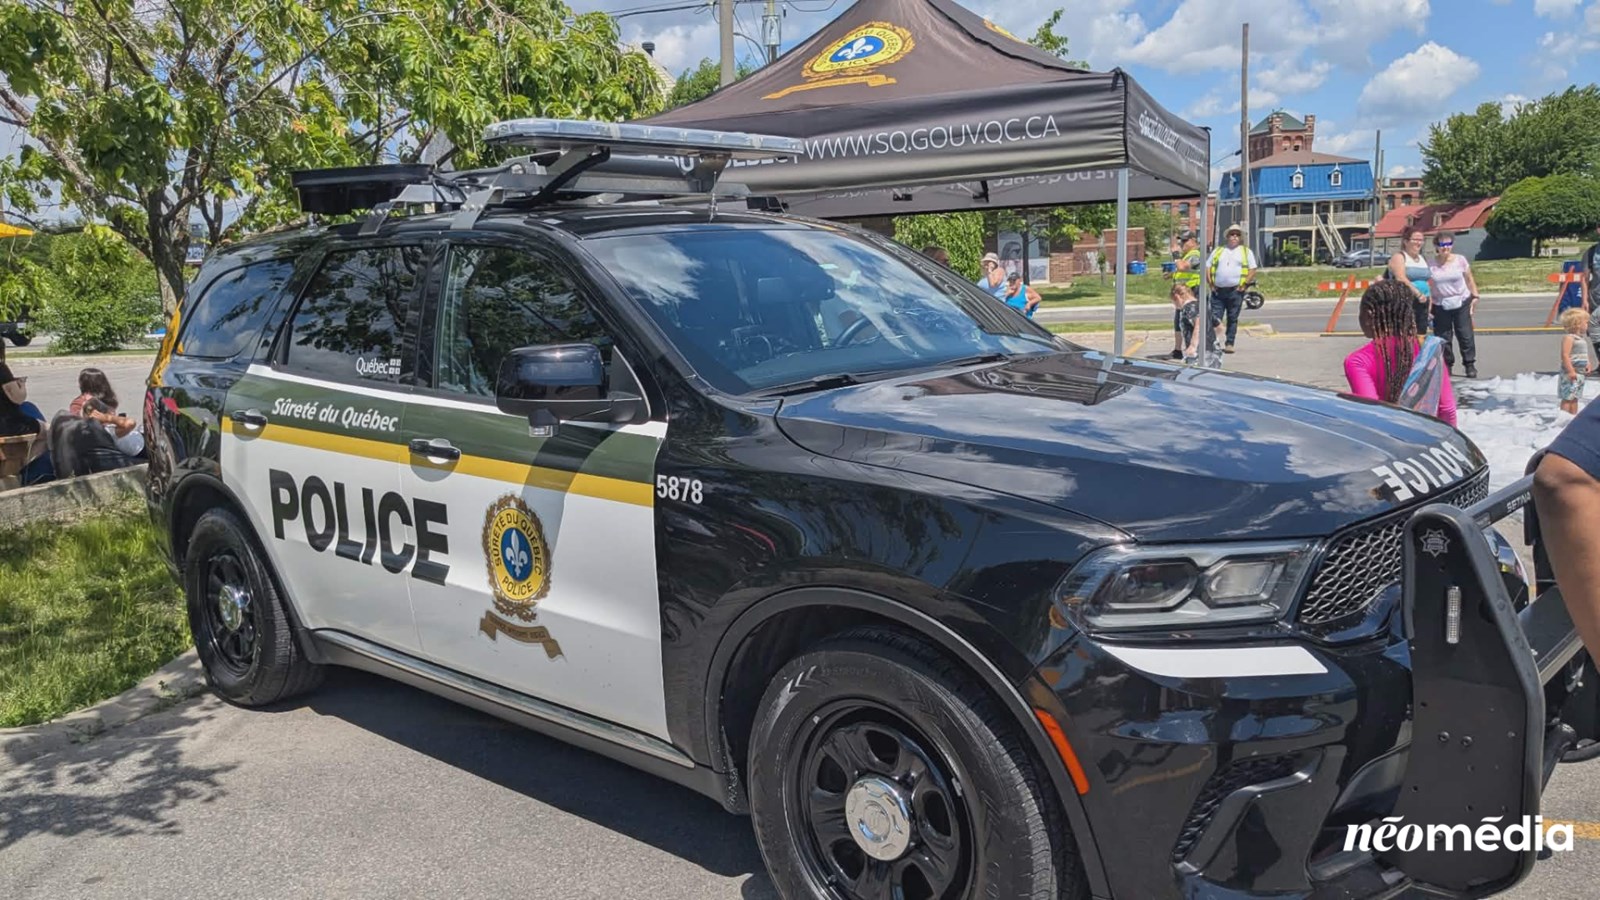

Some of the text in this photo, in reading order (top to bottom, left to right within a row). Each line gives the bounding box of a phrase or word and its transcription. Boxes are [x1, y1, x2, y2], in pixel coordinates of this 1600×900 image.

[805, 115, 1060, 160] WWW.SQ.GOUV.QC.CA
[356, 357, 388, 375] Québec
[271, 397, 399, 433] Sûreté du Québec
[656, 474, 704, 505] 5878
[269, 468, 450, 587] POLICE
[506, 512, 519, 525] DU
[502, 576, 533, 597] POLICE
